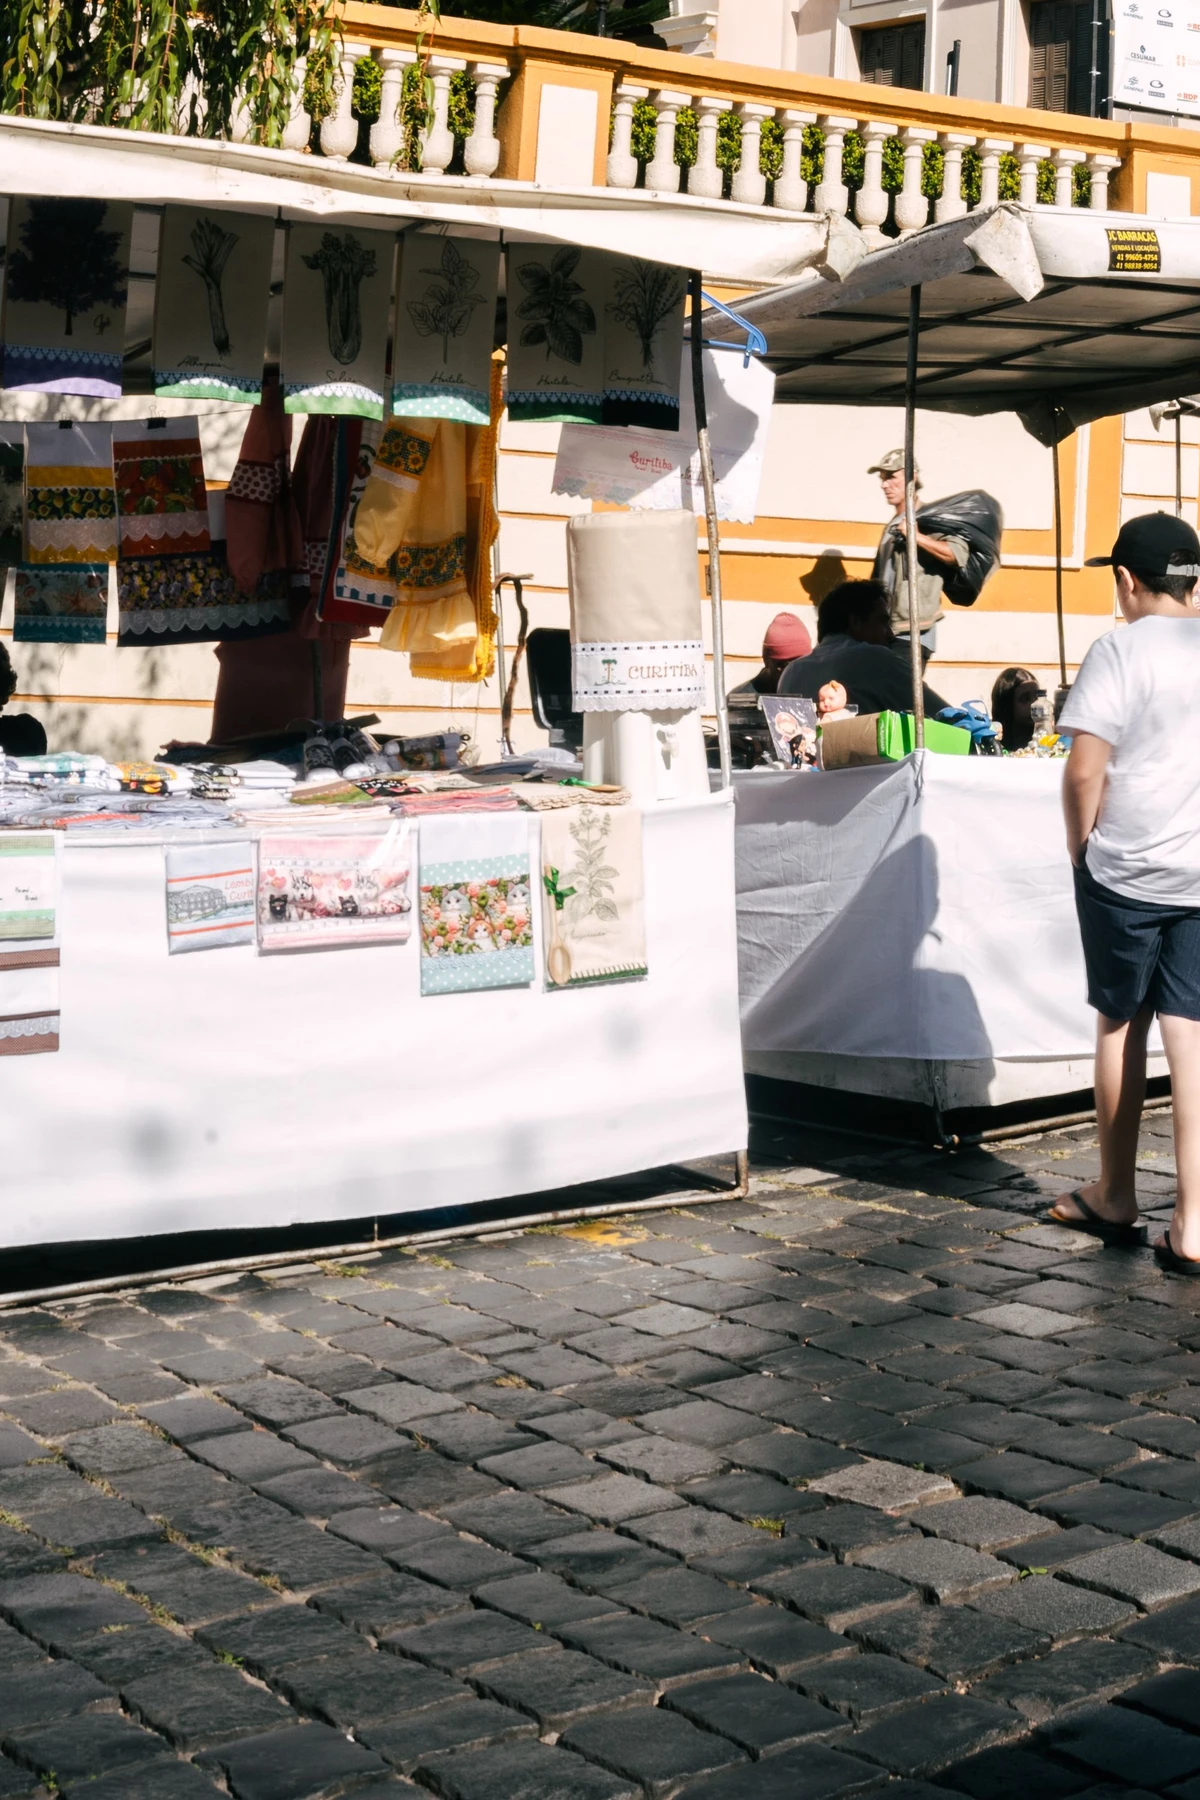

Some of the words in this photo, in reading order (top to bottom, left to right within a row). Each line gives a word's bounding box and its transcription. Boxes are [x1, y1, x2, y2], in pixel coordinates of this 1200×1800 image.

[1130, 52, 1156, 62] CESUMAR
[1183, 92, 1198, 100] RDP
[1108, 230, 1117, 240] JC
[1117, 231, 1157, 242] BARRACAS
[1135, 244, 1159, 252] LOCAÇÕES
[629, 450, 673, 470] Curitiba
